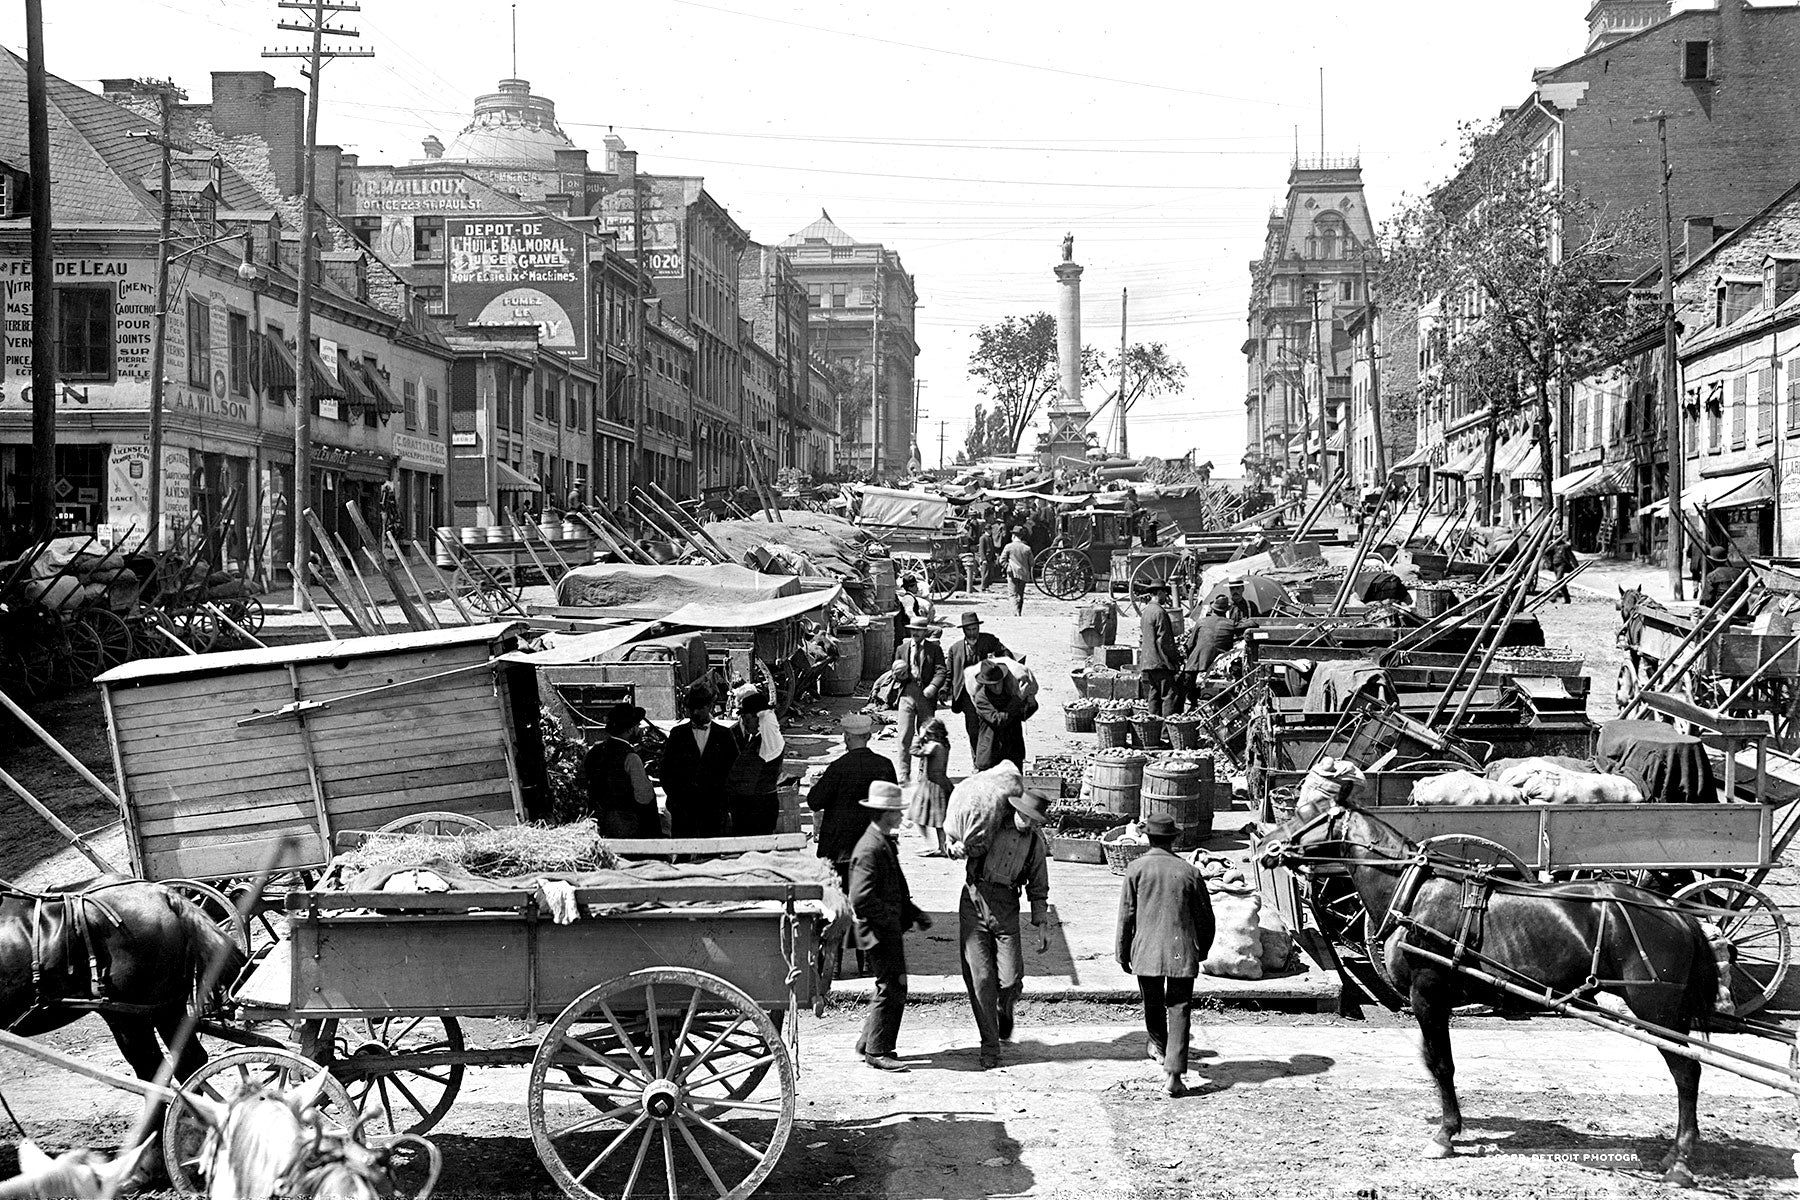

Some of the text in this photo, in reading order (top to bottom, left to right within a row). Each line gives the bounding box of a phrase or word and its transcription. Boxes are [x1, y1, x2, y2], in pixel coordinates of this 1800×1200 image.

[381, 178, 469, 195] MAILLOUX
[363, 200, 400, 210] OFFICE
[400, 200, 421, 210] 223
[439, 199, 468, 210] PAUL
[55, 262, 77, 276] DE
[6, 280, 32, 299] VITR
[7, 303, 32, 313] MAS
[115, 302, 156, 316] CAOUTCHO
[117, 320, 150, 330] POUR
[116, 334, 152, 344] JOINTS
[119, 348, 150, 356] SUR
[6, 355, 32, 365] PINCE
[117, 356, 149, 364] PIERRE
[117, 369, 151, 378] TAILLE
